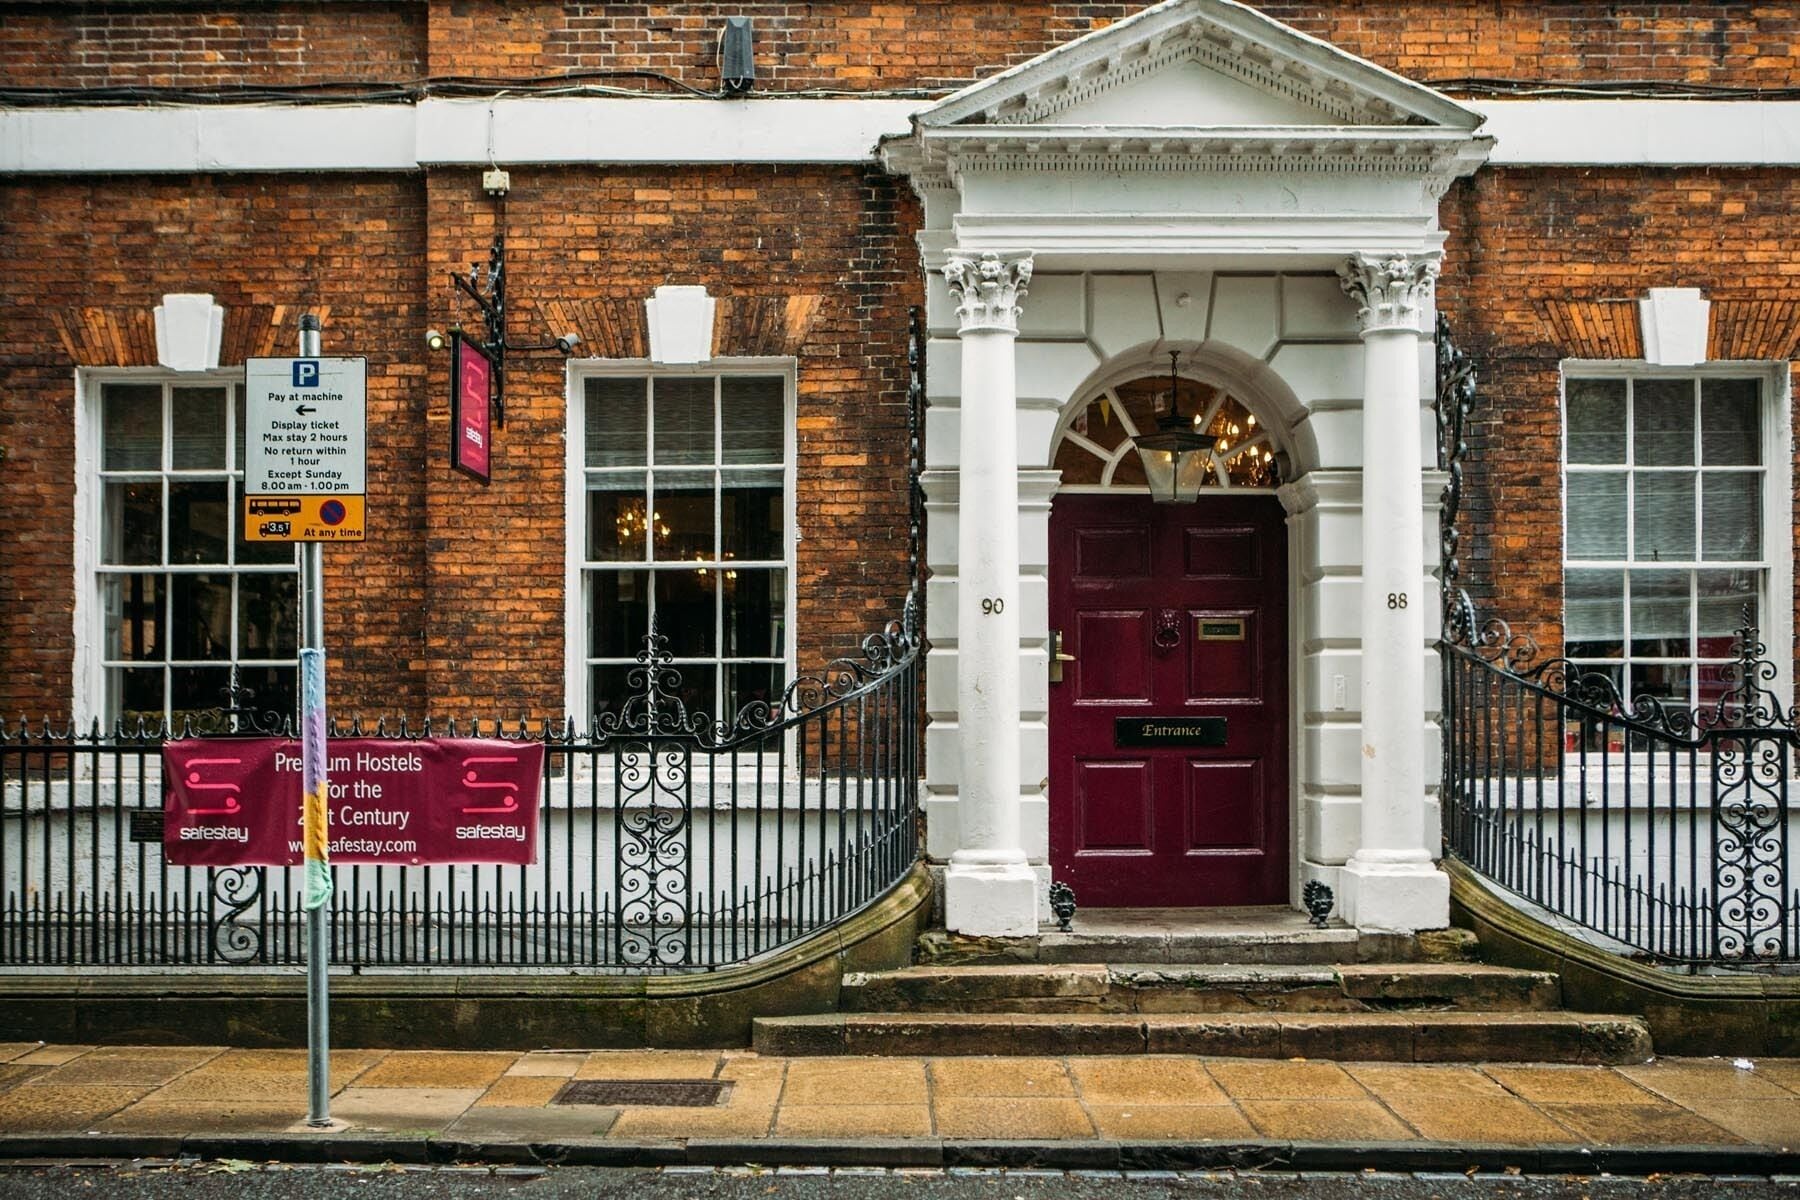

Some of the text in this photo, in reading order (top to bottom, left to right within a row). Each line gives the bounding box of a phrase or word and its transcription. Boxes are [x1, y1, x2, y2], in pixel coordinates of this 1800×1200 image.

[299, 364, 316, 385] P
[268, 392, 343, 403] Pay at machine
[271, 421, 340, 431] Display ticket
[263, 433, 348, 443] Max stay 2 hours
[264, 447, 347, 455] No return within
[290, 457, 321, 465] 1 hour
[268, 470, 342, 480] Except Sunday
[304, 528, 362, 539] At any time
[982, 598, 1004, 615] 90
[1387, 592, 1408, 610] 88
[1141, 724, 1201, 737] Entrance
[275, 752, 423, 772] Preum Hostels
[354, 779, 382, 798] the
[297, 805, 410, 830] 2t Century
[180, 825, 249, 843] safestay
[455, 824, 526, 842] safestay
[288, 837, 417, 856] wsafestay.com
